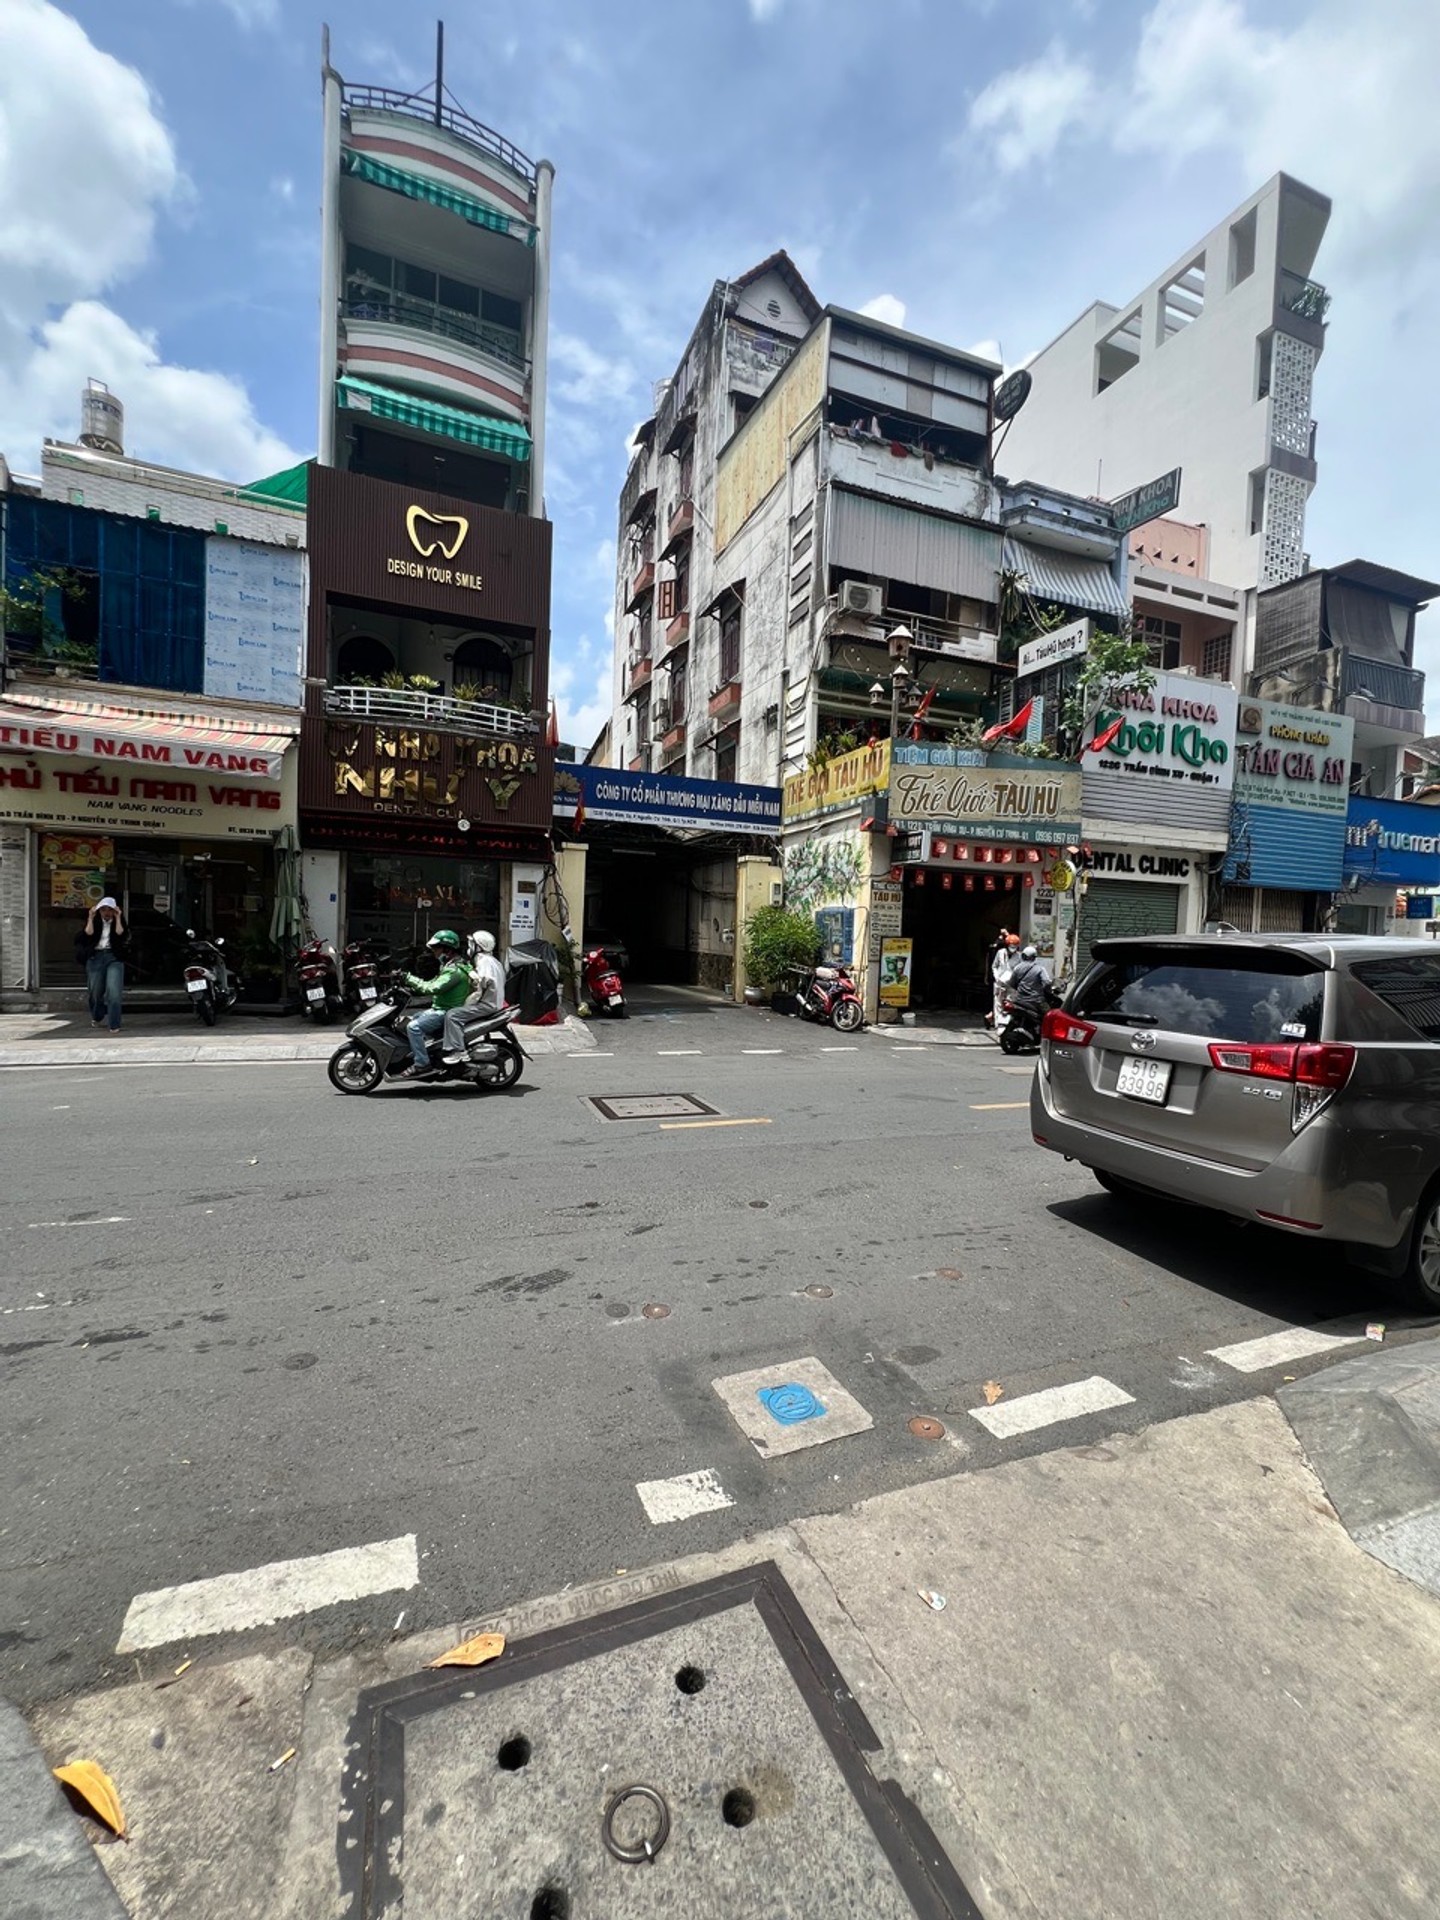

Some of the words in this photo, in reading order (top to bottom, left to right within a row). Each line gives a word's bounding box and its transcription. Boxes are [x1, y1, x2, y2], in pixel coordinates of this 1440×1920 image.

[1139, 475, 1173, 505] KHOA
[387, 558, 424, 578] DESIGN
[426, 566, 452, 584] YOUR
[455, 571, 482, 590] SMILE
[1162, 696, 1219, 723] KHOA
[0, 726, 78, 751] TIẾU
[94, 738, 170, 762] NAM
[184, 748, 269, 774] VANG
[1095, 710, 1166, 757] Khôi
[1172, 723, 1229, 767] Kha
[1270, 724, 1301, 741] PHÒNG
[1304, 730, 1330, 746] KHÁM
[895, 744, 928, 766] TIỆM
[1284, 752, 1316, 780] GIA
[1321, 756, 1346, 785] AN
[53, 766, 119, 795] TIẾU
[130, 777, 196, 802] NAM
[208, 785, 281, 809] VANG
[334, 761, 466, 805] NHƯ
[485, 773, 522, 811] Ý
[596, 781, 620, 800] CÔNG
[621, 786, 631, 802] TY
[632, 780, 643, 803] CỔ
[667, 790, 696, 808] THƯƠNG
[696, 793, 711, 813] MẠI
[711, 793, 731, 812] XĂNG
[764, 802, 780, 817] NAM
[896, 773, 946, 815] Thế
[993, 780, 1032, 817] TÀU
[1033, 779, 1063, 817] HŨ
[87, 800, 114, 809] NAM
[119, 803, 147, 812] VANG
[151, 805, 203, 816] NOODLES
[373, 802, 432, 816] DENTAL
[1139, 855, 1190, 877] CLINIC
[1131, 1059, 1159, 1079] 51G
[1118, 1074, 1164, 1099] 339.96
